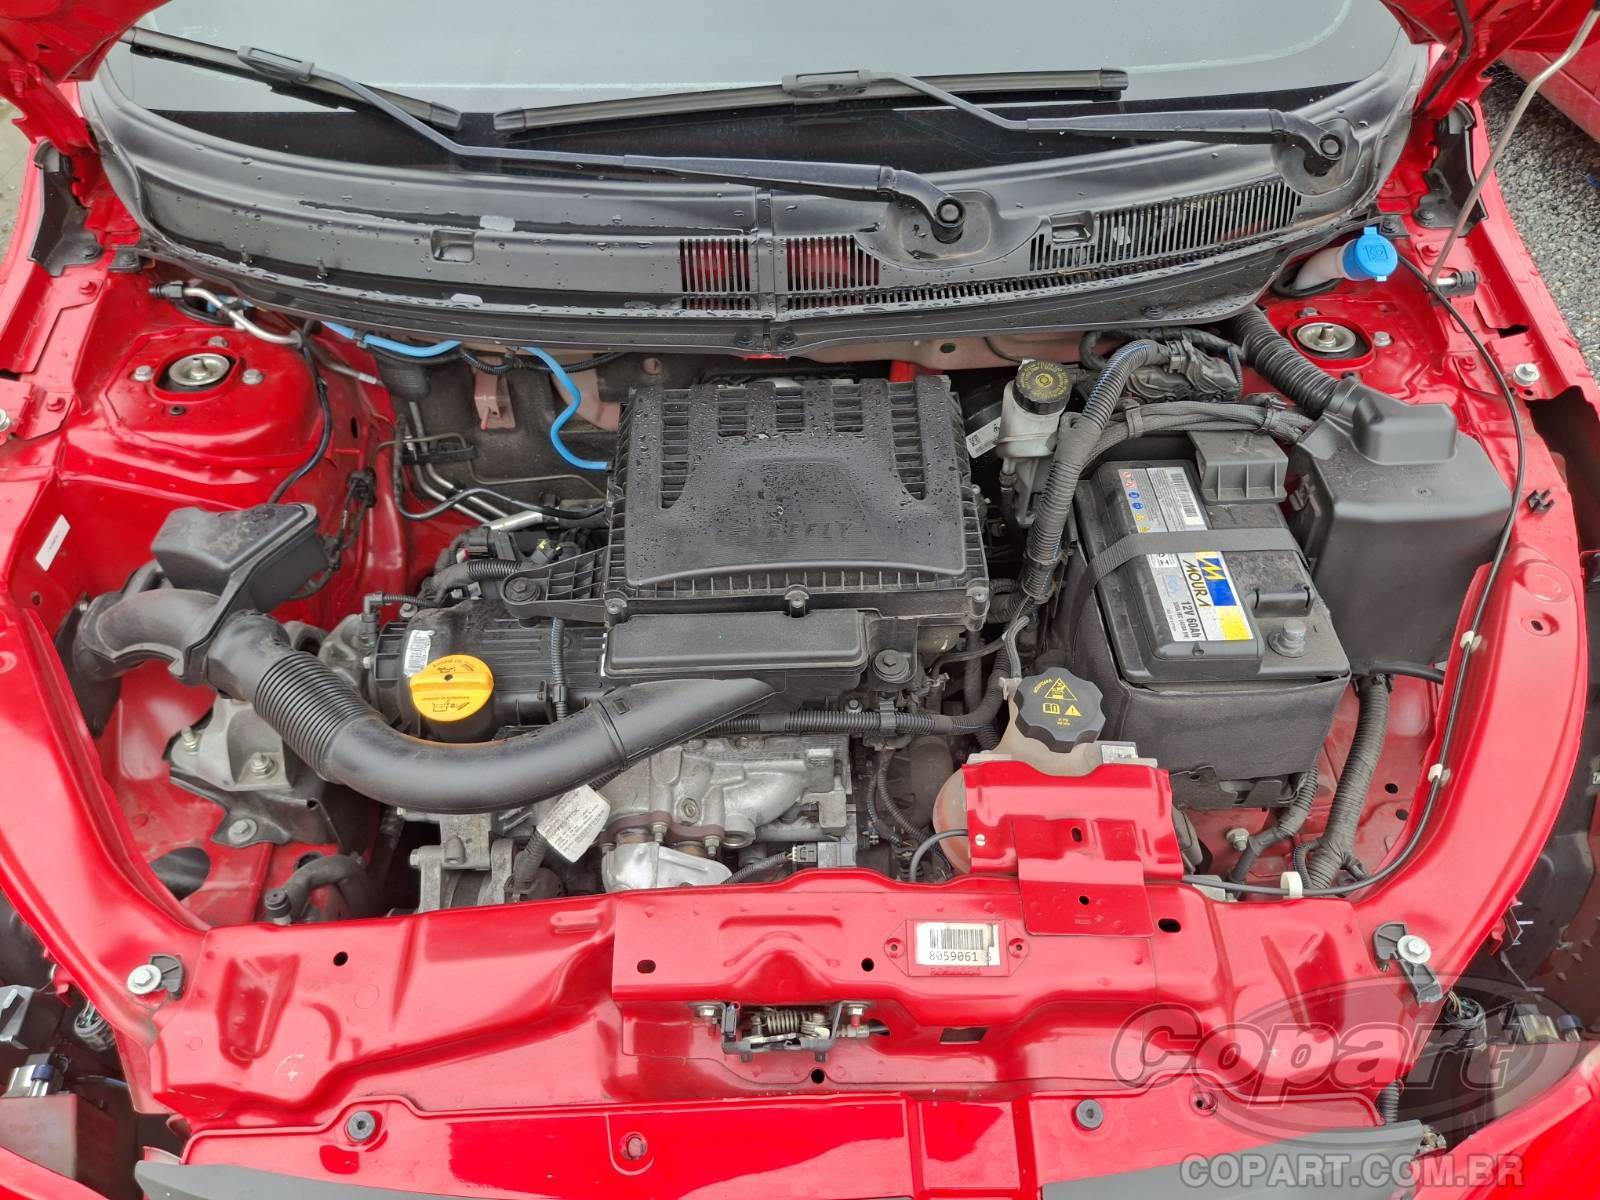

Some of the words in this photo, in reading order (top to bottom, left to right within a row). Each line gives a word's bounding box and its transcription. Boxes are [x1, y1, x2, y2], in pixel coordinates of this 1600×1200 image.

[1183, 559, 1213, 607] MOURA
[1180, 601, 1195, 617] 12V
[1187, 617, 1202, 639] 60Ah
[929, 951, 979, 962] 8059061
